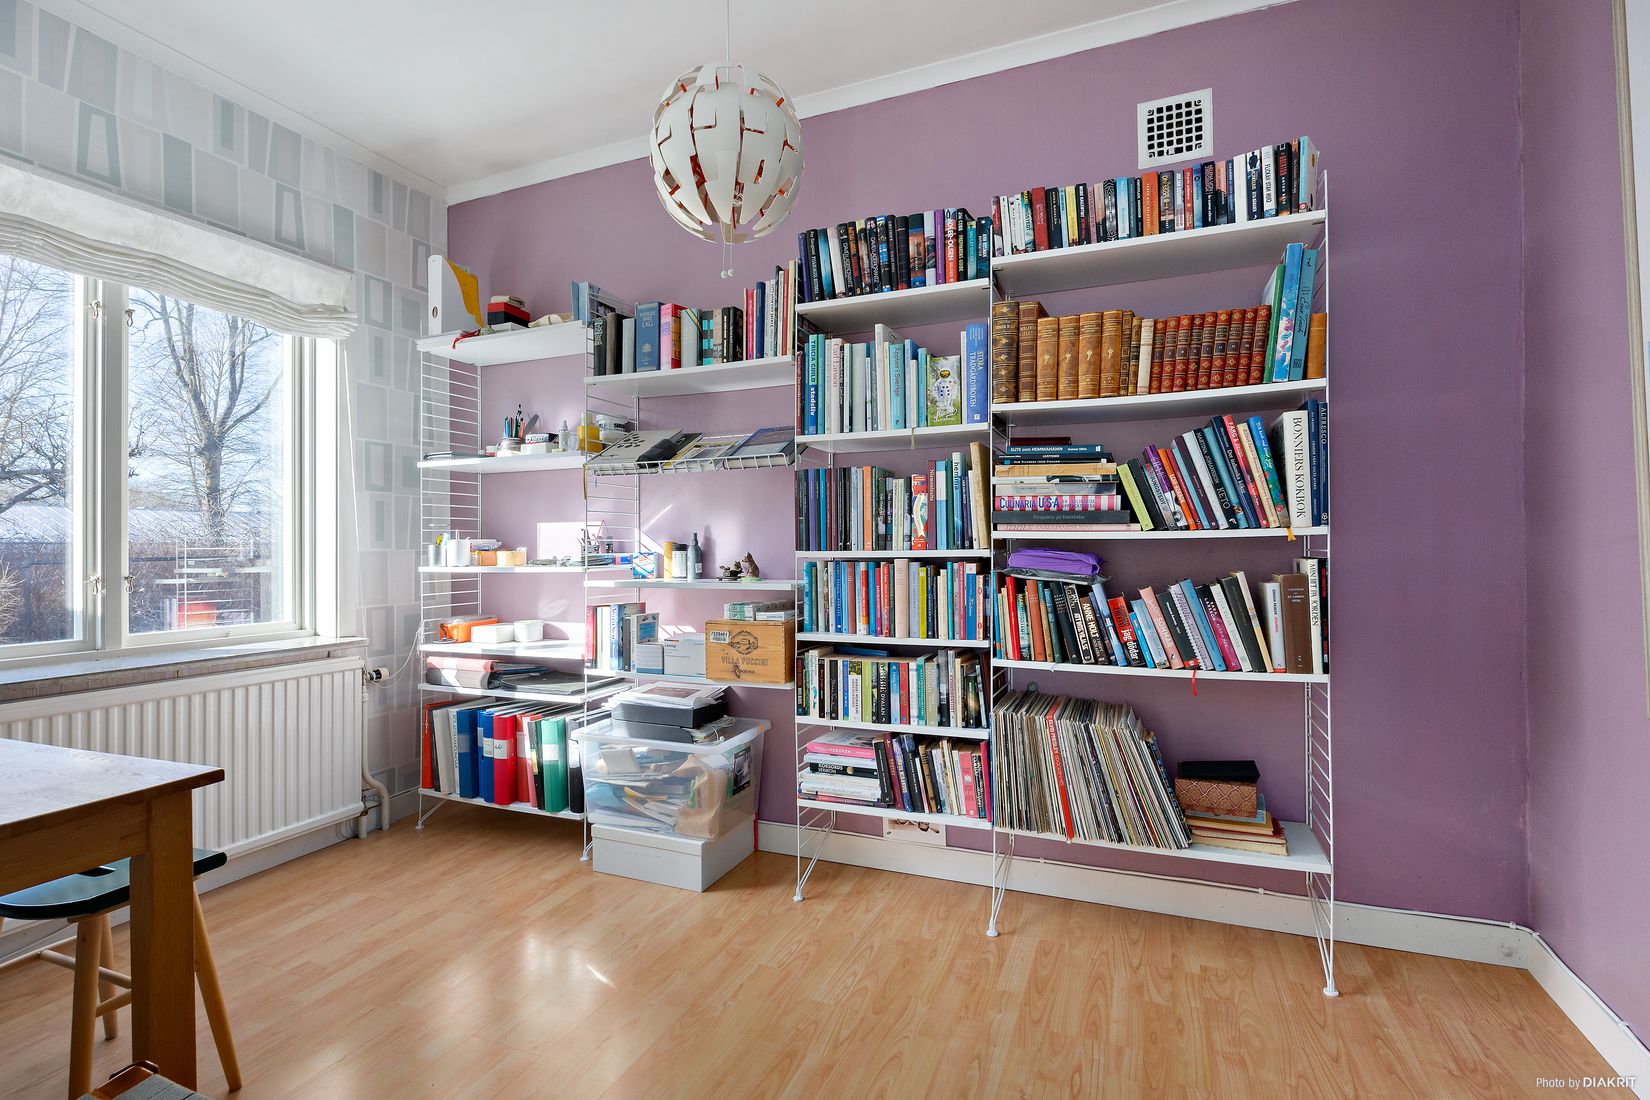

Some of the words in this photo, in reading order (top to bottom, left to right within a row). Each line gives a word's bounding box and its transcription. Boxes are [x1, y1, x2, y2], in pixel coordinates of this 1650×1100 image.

[832, 343, 840, 359] Carl
[893, 347, 901, 368] Äpplen
[831, 361, 840, 388] Larsson
[893, 373, 901, 397] Sverige
[969, 351, 977, 407] TRÄDGÅRDSBOKEN
[1292, 417, 1304, 471] BONNIERS
[1196, 432, 1208, 454] MARTINA
[1205, 455, 1220, 484] JOHANSSON
[1216, 486, 1231, 509] KETO
[999, 498, 1036, 509] CULINARIA
[1295, 474, 1306, 519] KOKBOK
[1082, 603, 1094, 622] ANNE
[1088, 622, 1099, 638] HOLT
[1204, 597, 1216, 622] LARSSON
[1121, 628, 1133, 641] jag
[1157, 616, 1173, 648] SOMMAR
[720, 656, 740, 665] VILLA
[741, 657, 769, 668] PUCCINI
[1126, 641, 1139, 660] dödar
[1051, 732, 1059, 754] PRESLEY
